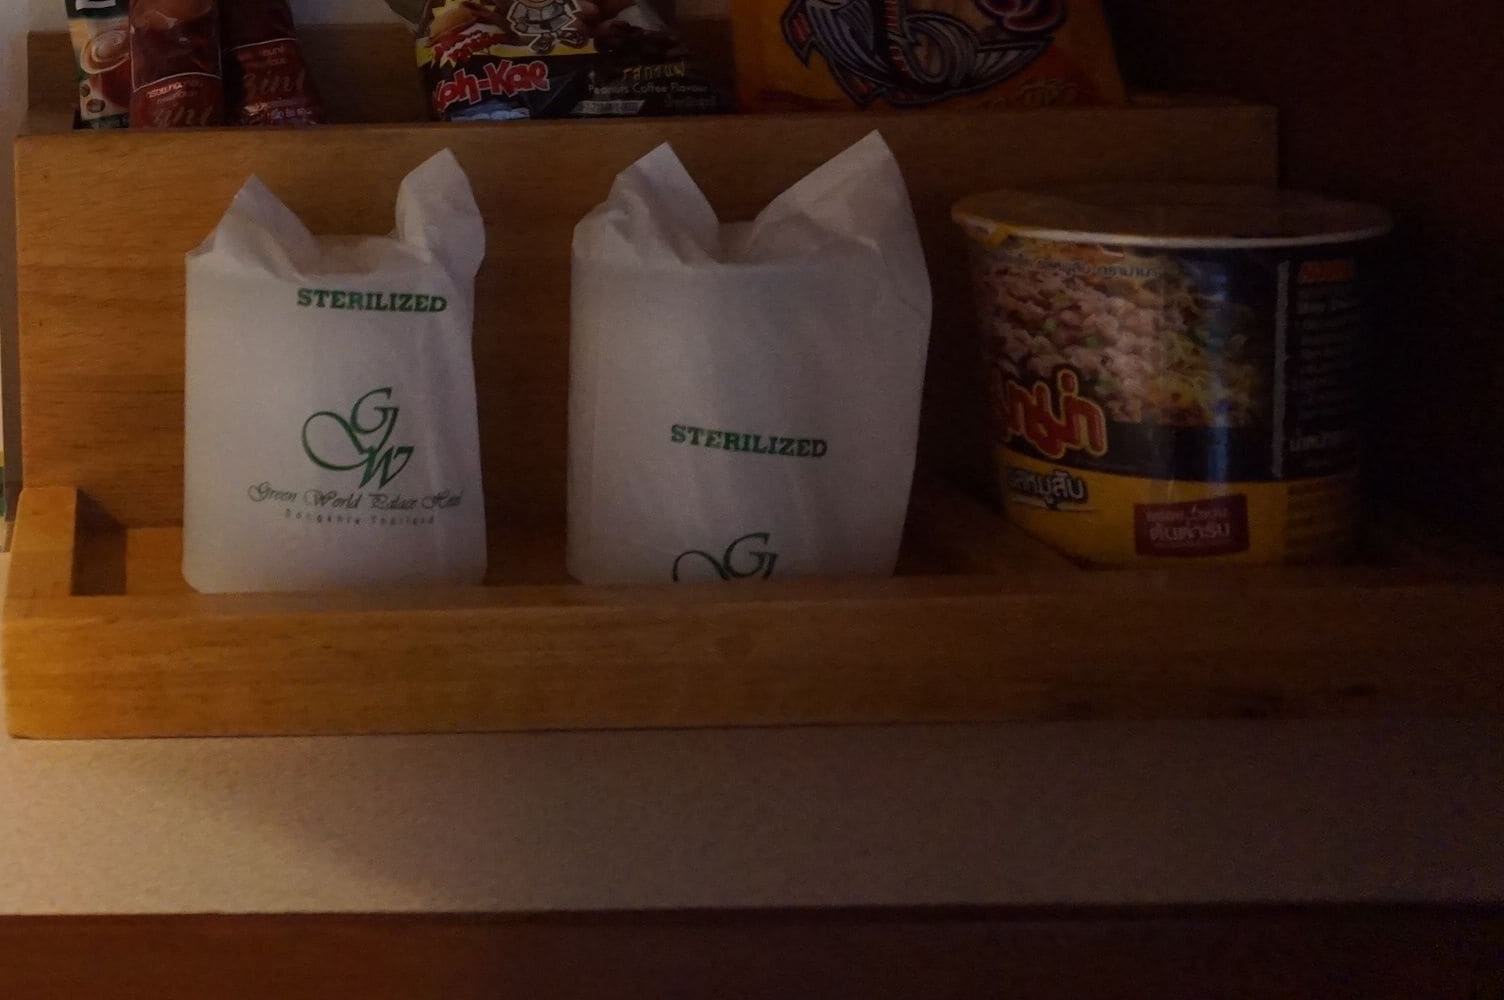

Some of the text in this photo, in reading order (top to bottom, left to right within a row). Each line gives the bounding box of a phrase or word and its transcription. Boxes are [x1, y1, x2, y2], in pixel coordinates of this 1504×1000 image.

[434, 59, 551, 112] oh-Kae
[297, 288, 447, 313] STERILIZED
[670, 424, 828, 457] STERILIZED
[248, 481, 297, 503] Green
[303, 488, 362, 509] World
